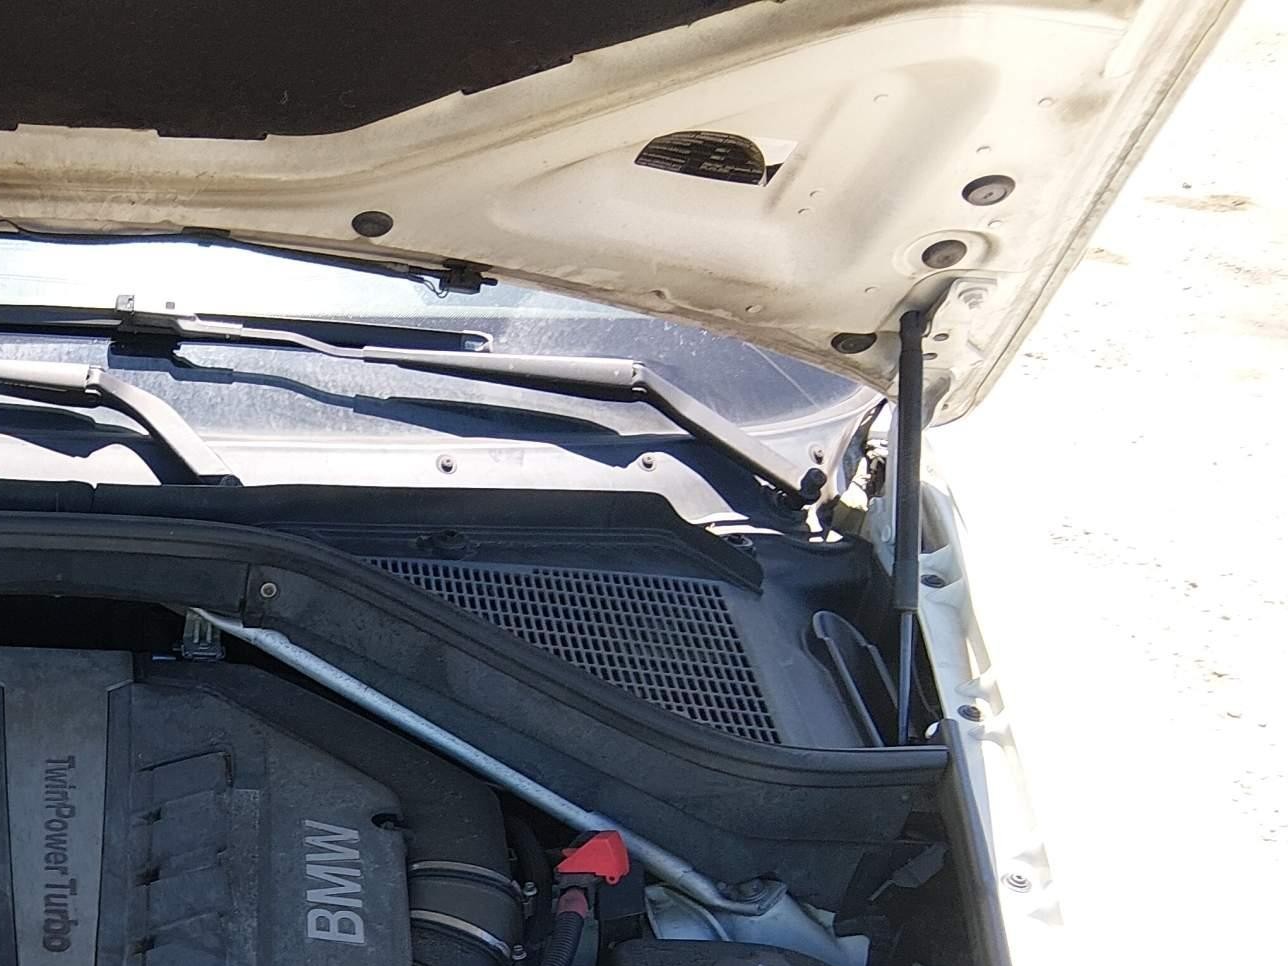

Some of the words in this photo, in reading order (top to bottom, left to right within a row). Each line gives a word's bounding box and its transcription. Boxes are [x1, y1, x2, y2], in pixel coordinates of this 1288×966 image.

[44, 756, 77, 875] TwinPower
[43, 878, 78, 953] Turbo
[304, 819, 364, 943] BMW
